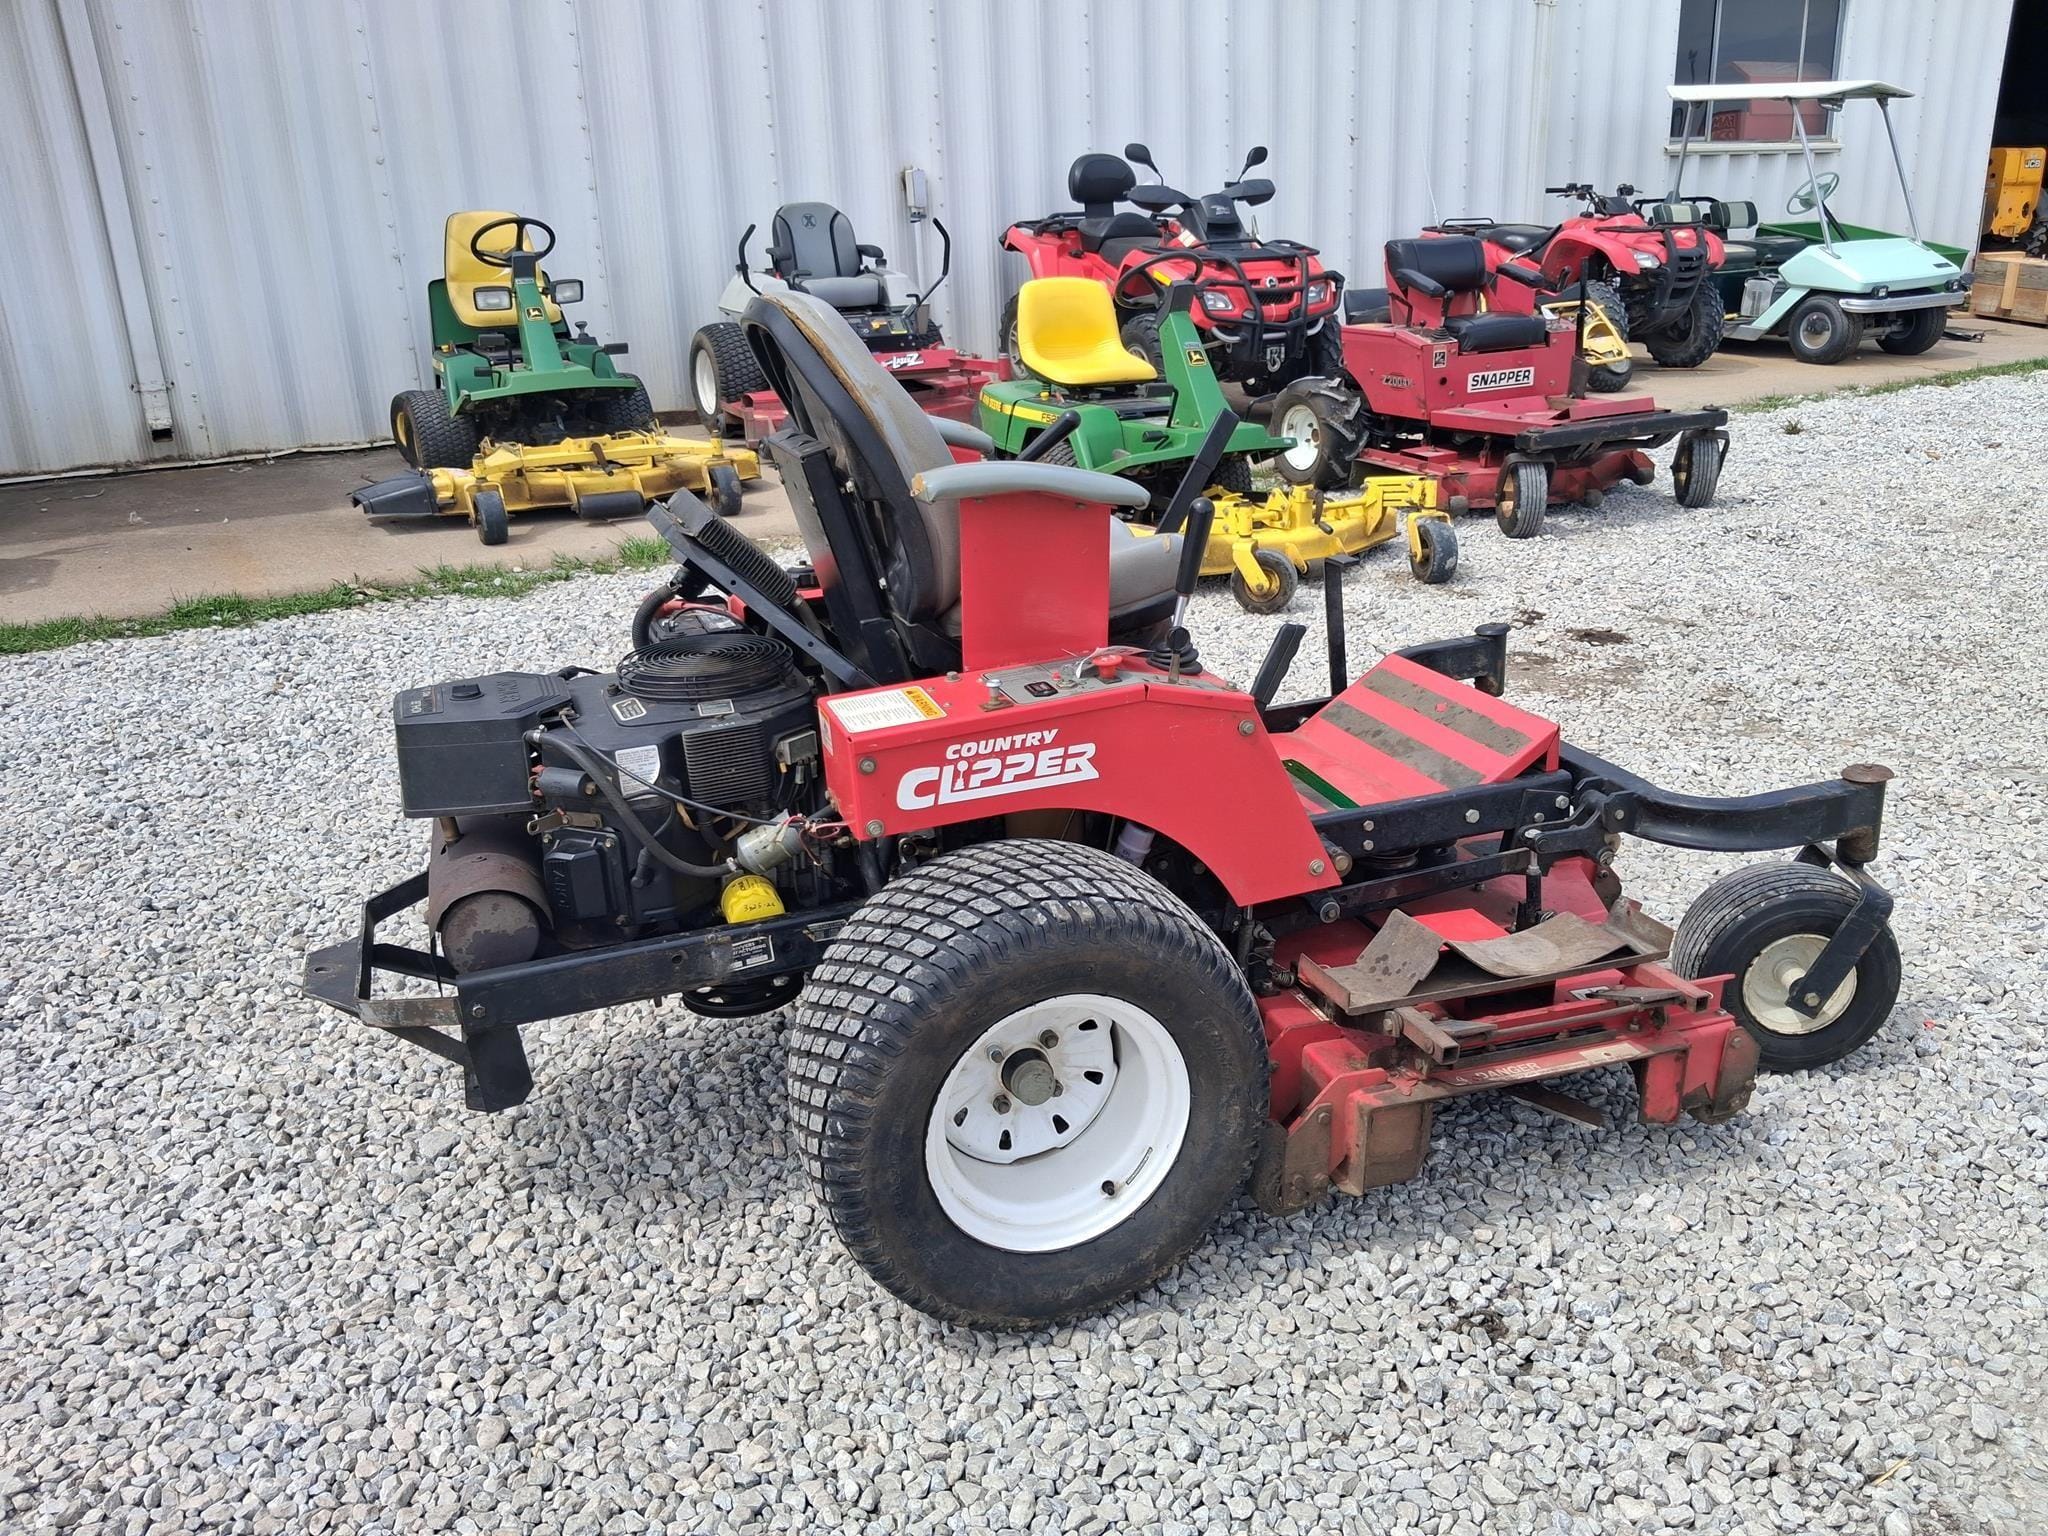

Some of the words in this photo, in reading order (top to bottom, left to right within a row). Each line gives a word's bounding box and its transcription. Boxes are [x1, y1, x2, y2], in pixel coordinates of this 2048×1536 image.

[2025, 160, 2041, 168] JCB
[1471, 369, 1531, 388] SNAPPER
[946, 729, 1058, 759] COUNTRY
[896, 742, 1100, 811] CLIPPER
[1475, 1062, 1541, 1080] DANGER
